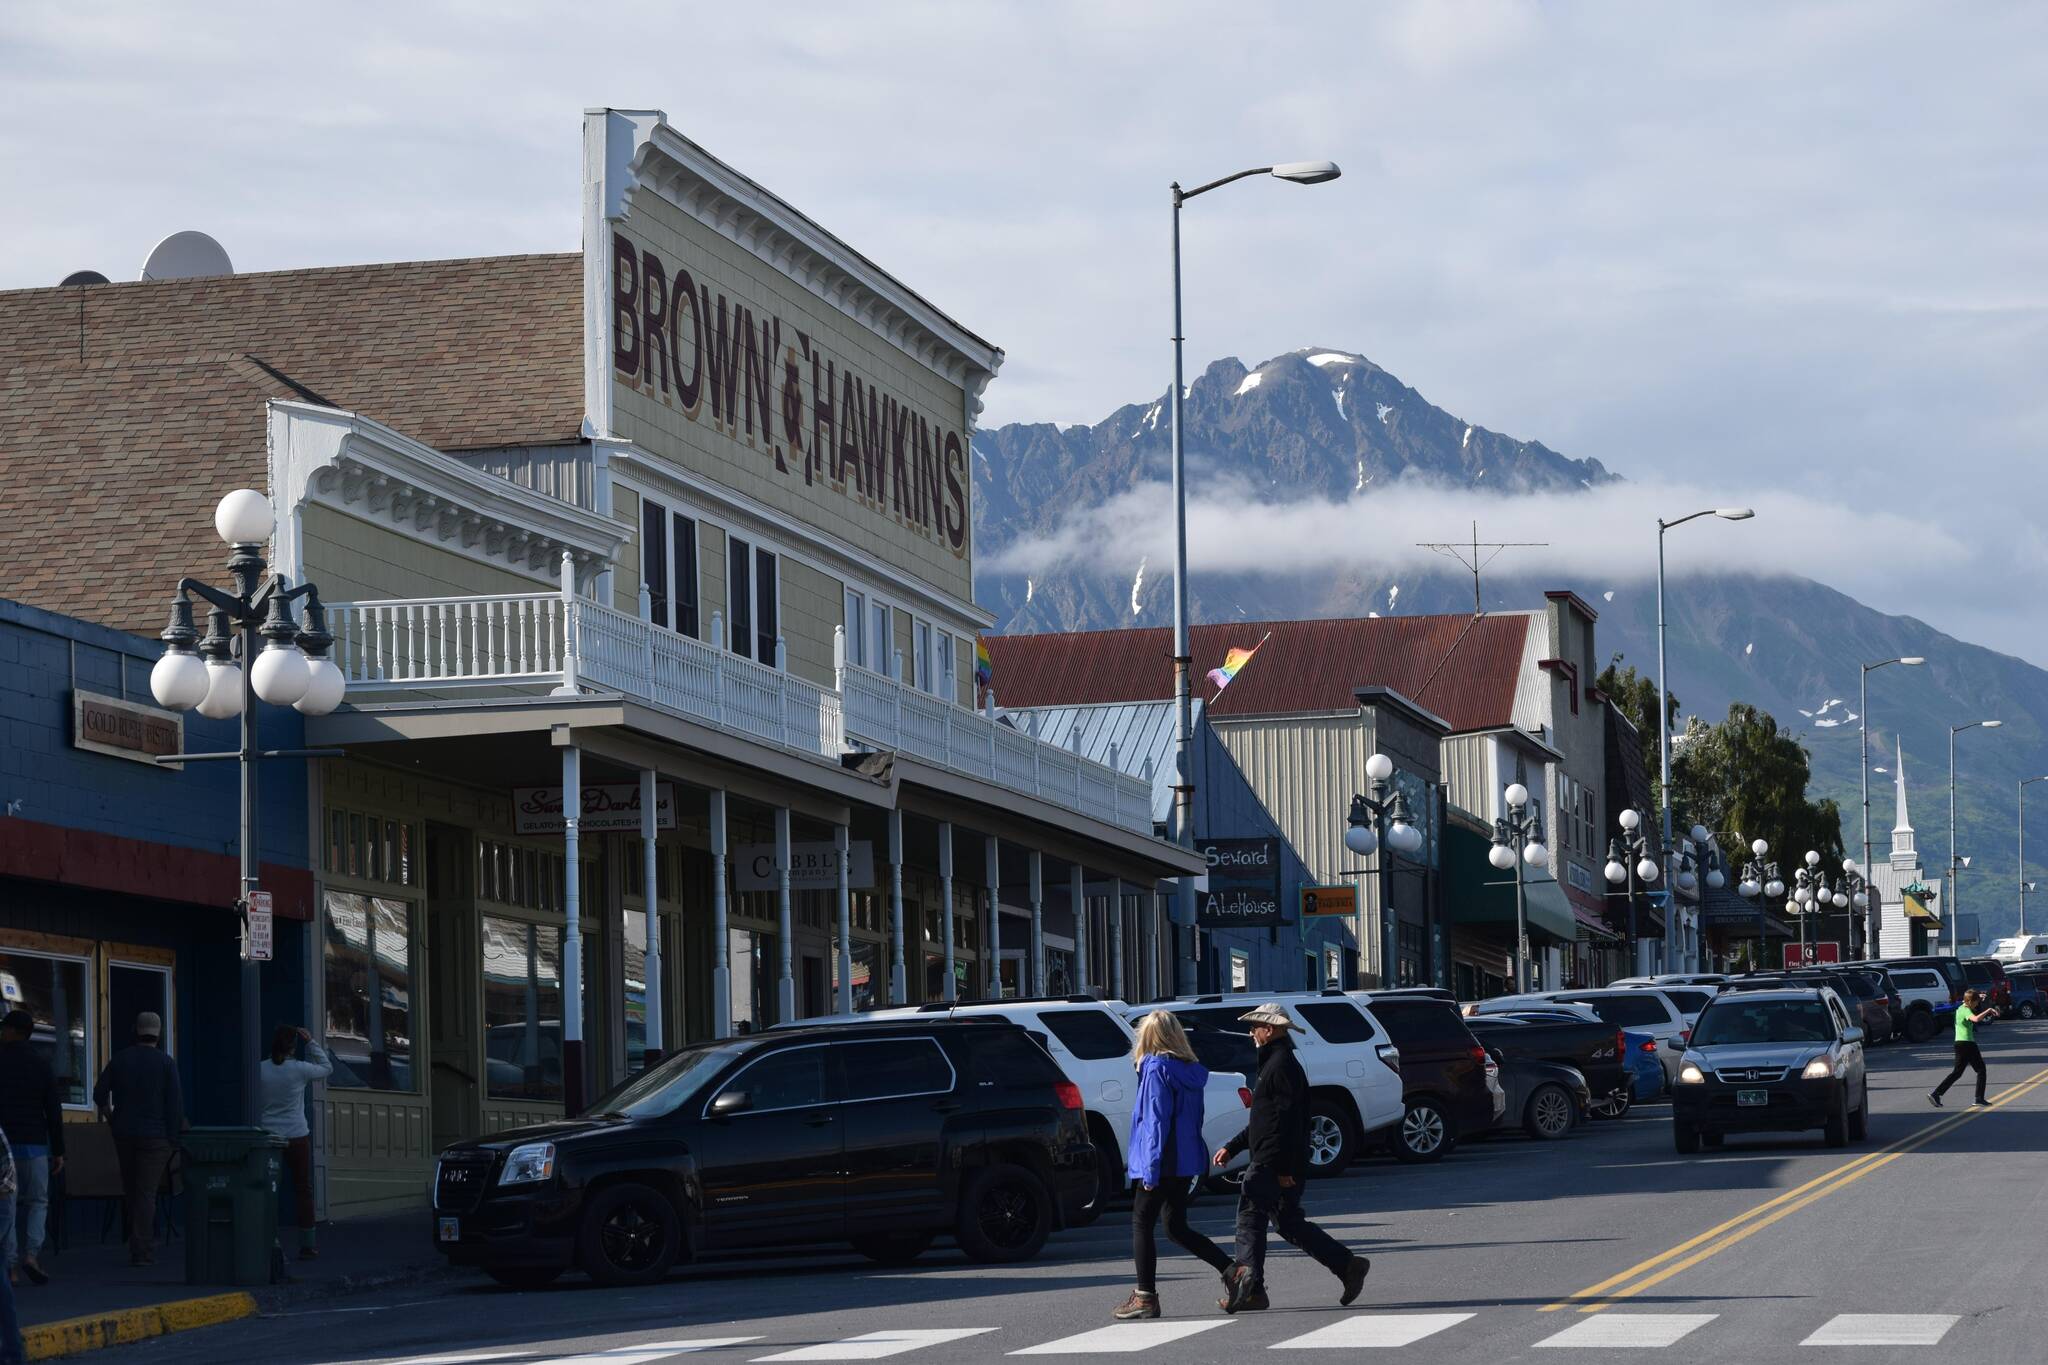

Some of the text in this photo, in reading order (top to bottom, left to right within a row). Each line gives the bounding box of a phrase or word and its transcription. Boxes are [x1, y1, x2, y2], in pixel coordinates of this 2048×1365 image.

[614, 232, 771, 450] BROWN
[812, 348, 968, 554] HAWKINS
[87, 710, 116, 734] GOLD
[580, 787, 668, 813] Darlis
[752, 853, 853, 878] CBBLE
[1205, 843, 1268, 867] Seward
